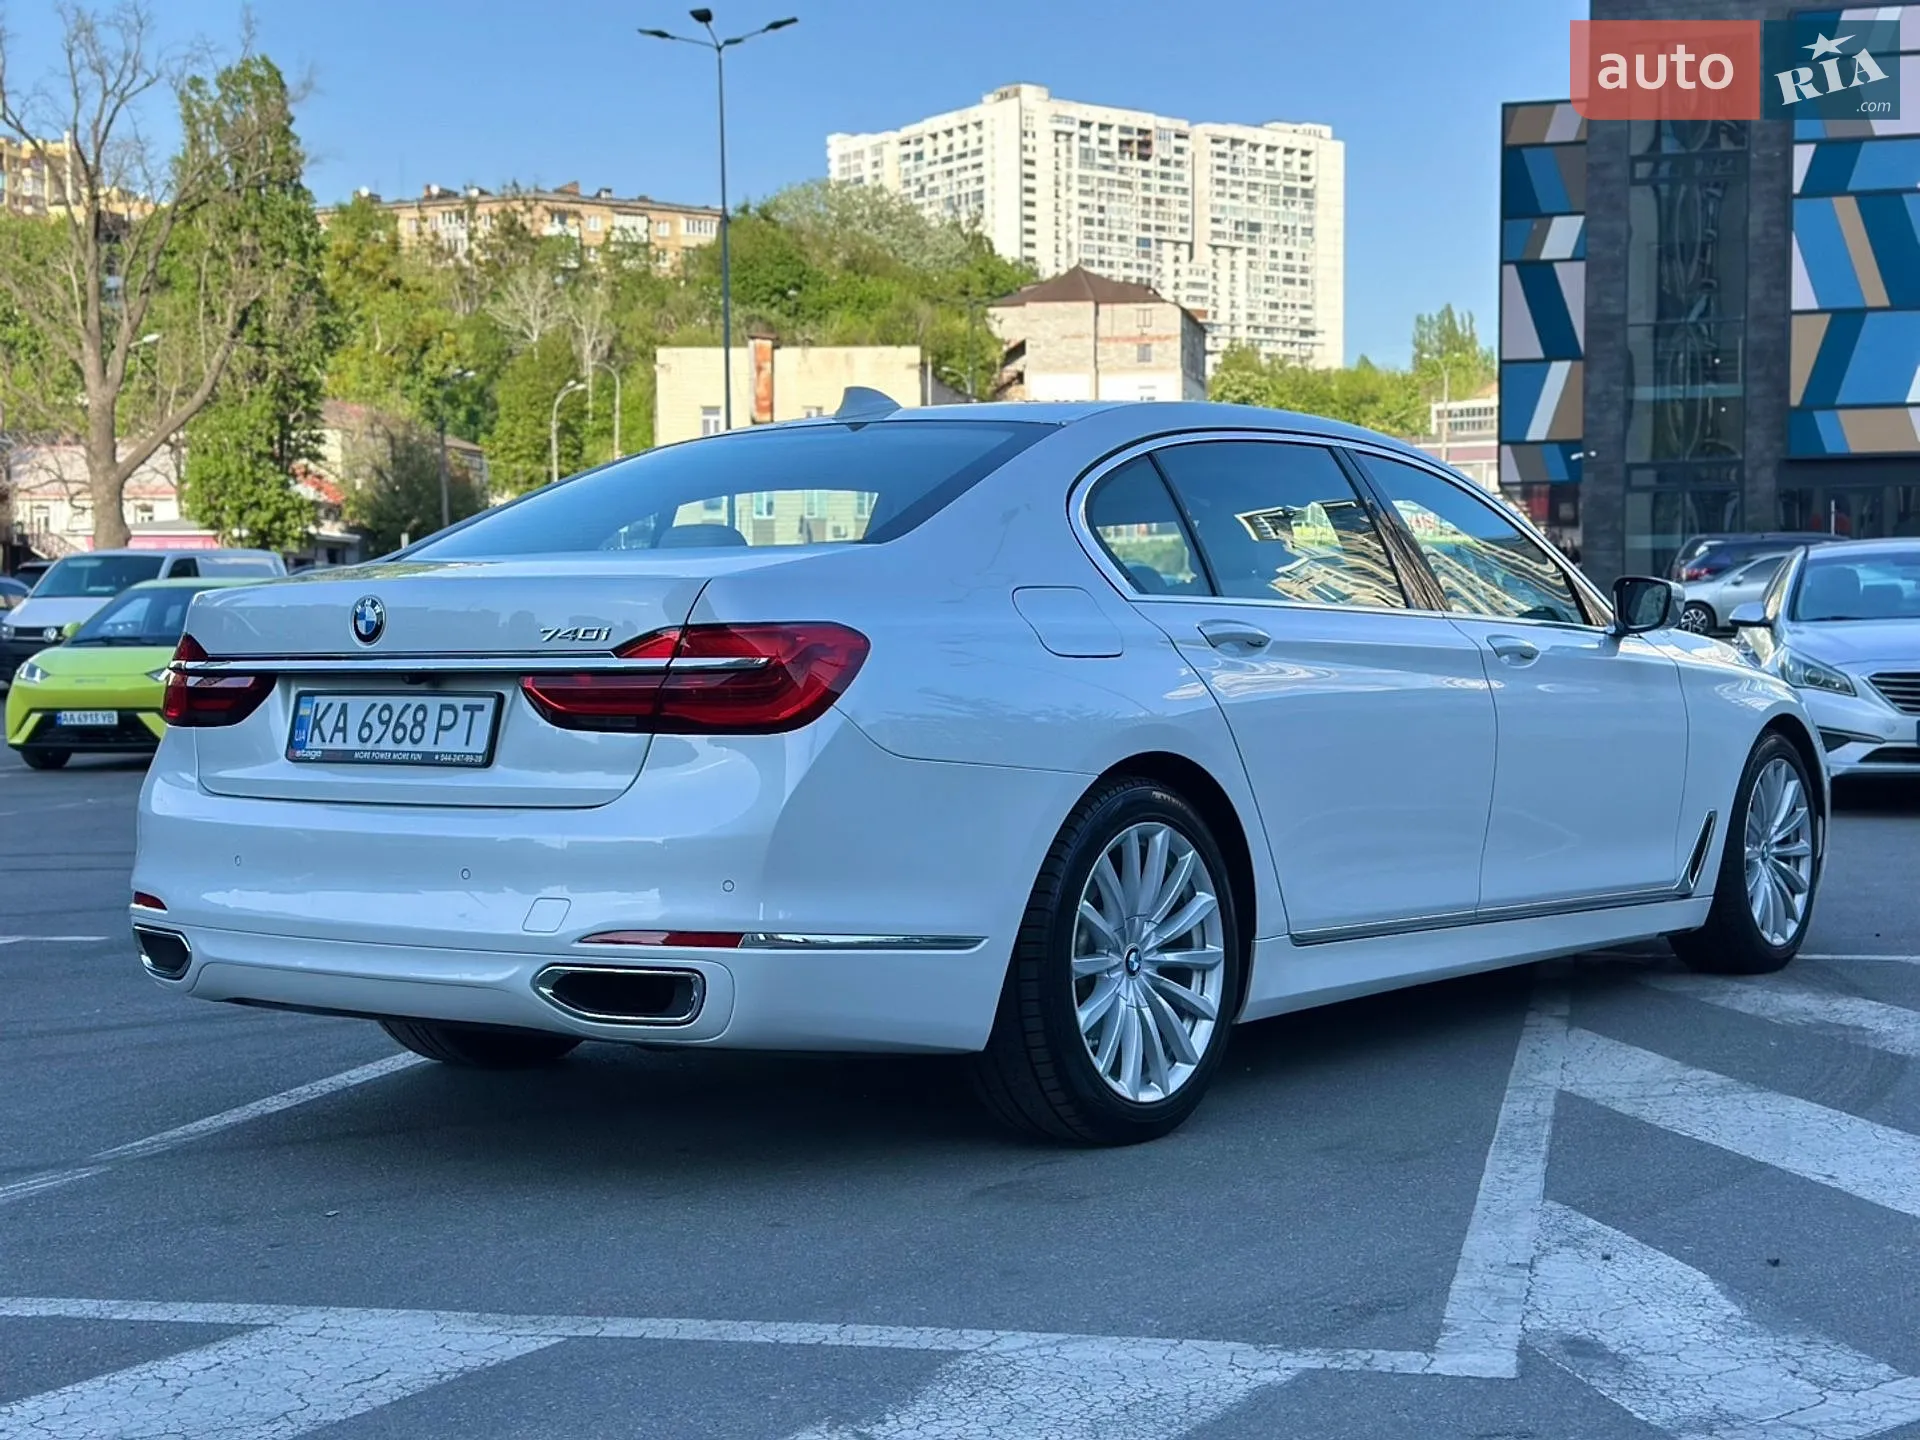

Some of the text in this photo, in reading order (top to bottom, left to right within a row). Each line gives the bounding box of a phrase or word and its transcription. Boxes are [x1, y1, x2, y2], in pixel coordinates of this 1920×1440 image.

[354, 597, 384, 615] BMW
[539, 626, 612, 643] 740i
[309, 701, 485, 746] KA 6968 PT
